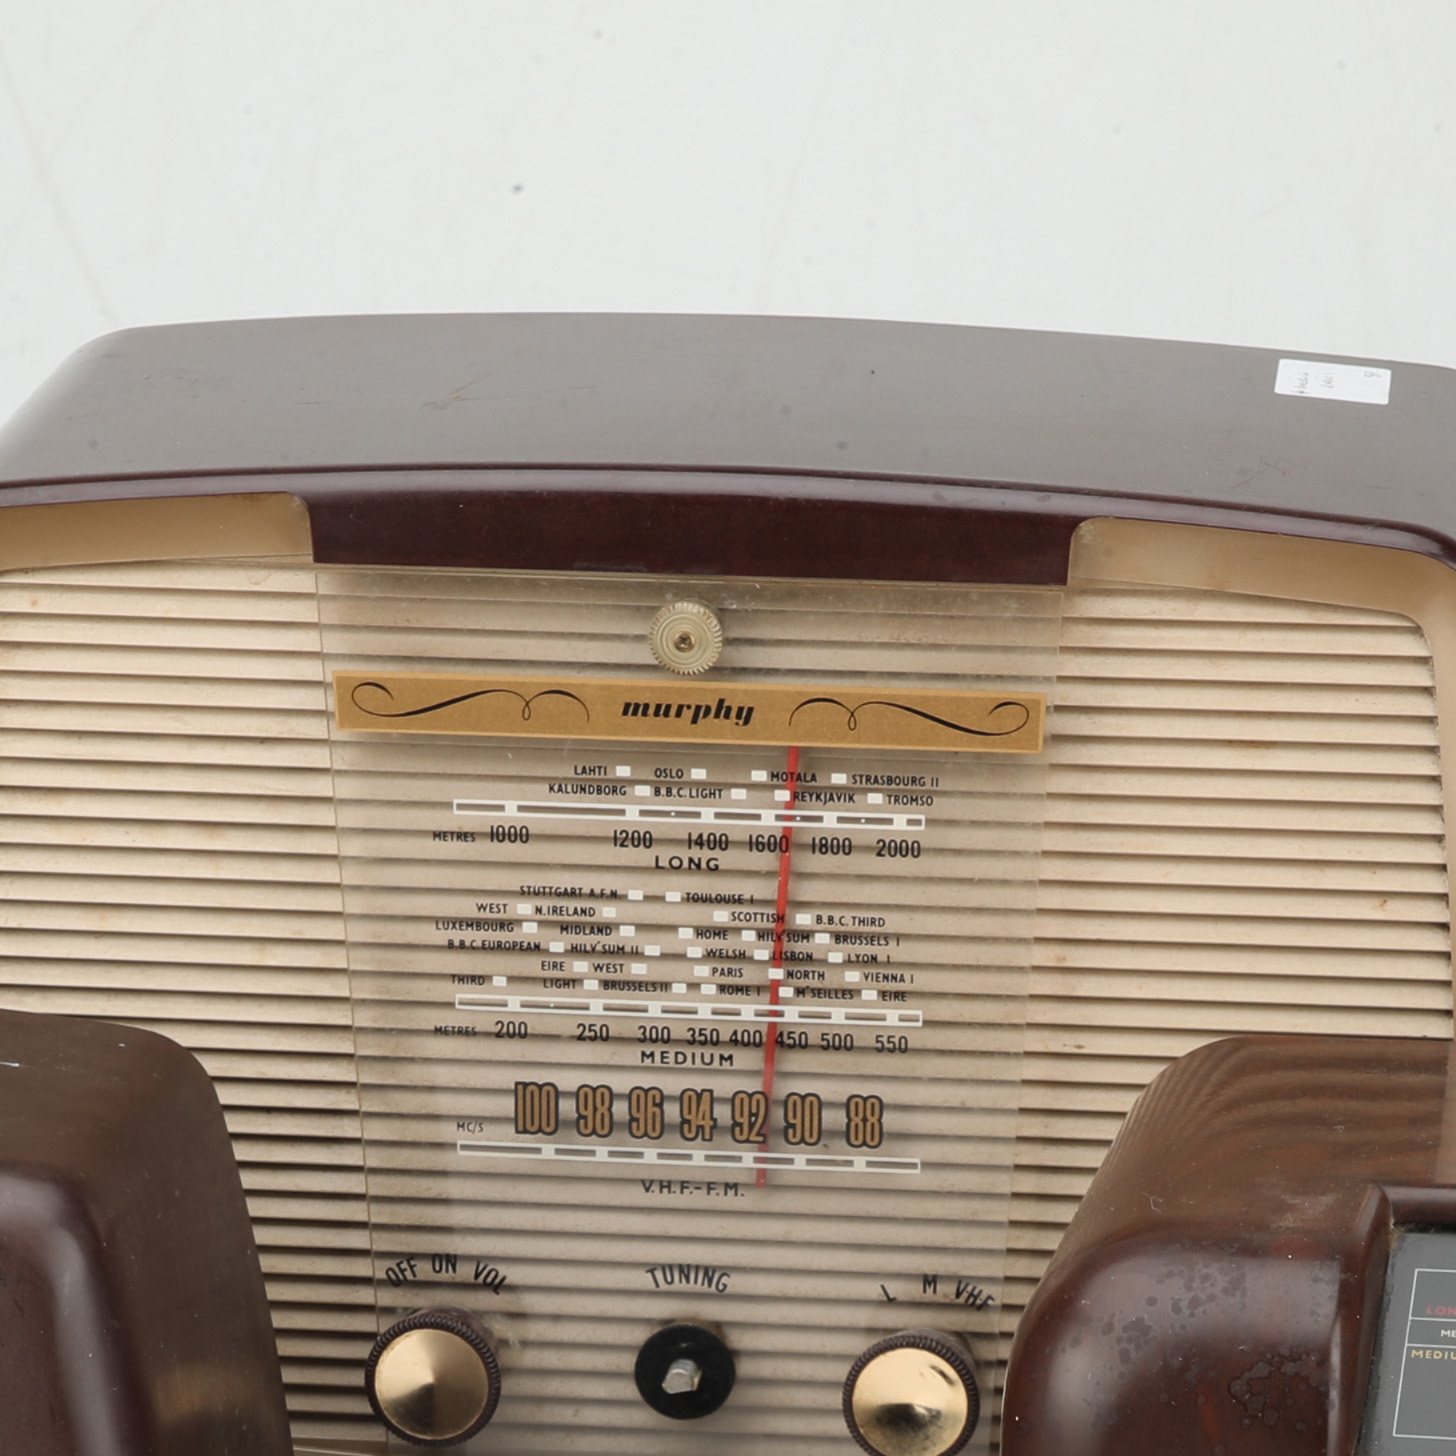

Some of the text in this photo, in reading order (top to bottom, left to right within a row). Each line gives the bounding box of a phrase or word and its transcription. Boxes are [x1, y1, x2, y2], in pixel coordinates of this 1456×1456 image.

[621, 698, 755, 726] murphy
[574, 765, 607, 776] LAHTI
[654, 767, 684, 779] OSLO
[770, 771, 817, 783] MOTALA
[852, 774, 926, 787] STRASBOURG
[548, 783, 627, 796] KALUNDBORG
[793, 791, 856, 805] REYKJAVIK
[887, 794, 934, 807] TROMSO
[432, 825, 921, 858] METRES 1000 1200 1400 1600 1800 2000
[655, 855, 720, 872] LONG
[520, 886, 583, 898] STUTTGART
[685, 892, 744, 904] TOULOUSE
[476, 903, 508, 914] WEST
[731, 911, 785, 924] SCOTTISH
[435, 920, 514, 933] LUXEMBOURG
[560, 925, 612, 936] MIDLAND
[696, 929, 729, 940] HOME
[834, 933, 890, 947] BRUSSELS
[705, 948, 746, 960] WELSH
[772, 950, 814, 962] LISBON
[847, 953, 878, 965] LYON
[541, 961, 566, 972] EIRE
[592, 963, 625, 974] WEST
[712, 967, 744, 978] PARIS
[451, 975, 485, 986] THIRD
[787, 970, 825, 981] NORTH
[863, 971, 906, 984] VIENNA
[543, 978, 577, 990] LIGHT
[603, 979, 658, 992] BRUSSELS
[719, 985, 752, 997] ROME
[881, 990, 908, 1002] EIRE
[433, 1020, 908, 1054] METRES 200 250 300 350 400 450 500 550
[640, 1050, 734, 1067] MEDIUM
[456, 1081, 884, 1149] MC/S 100 98 96 94 92 90 88
[385, 1253, 507, 1295] OFF ON VOL
[646, 1263, 731, 1293] TUNING
[880, 1284, 897, 1302] L
[922, 1274, 938, 1295] M
